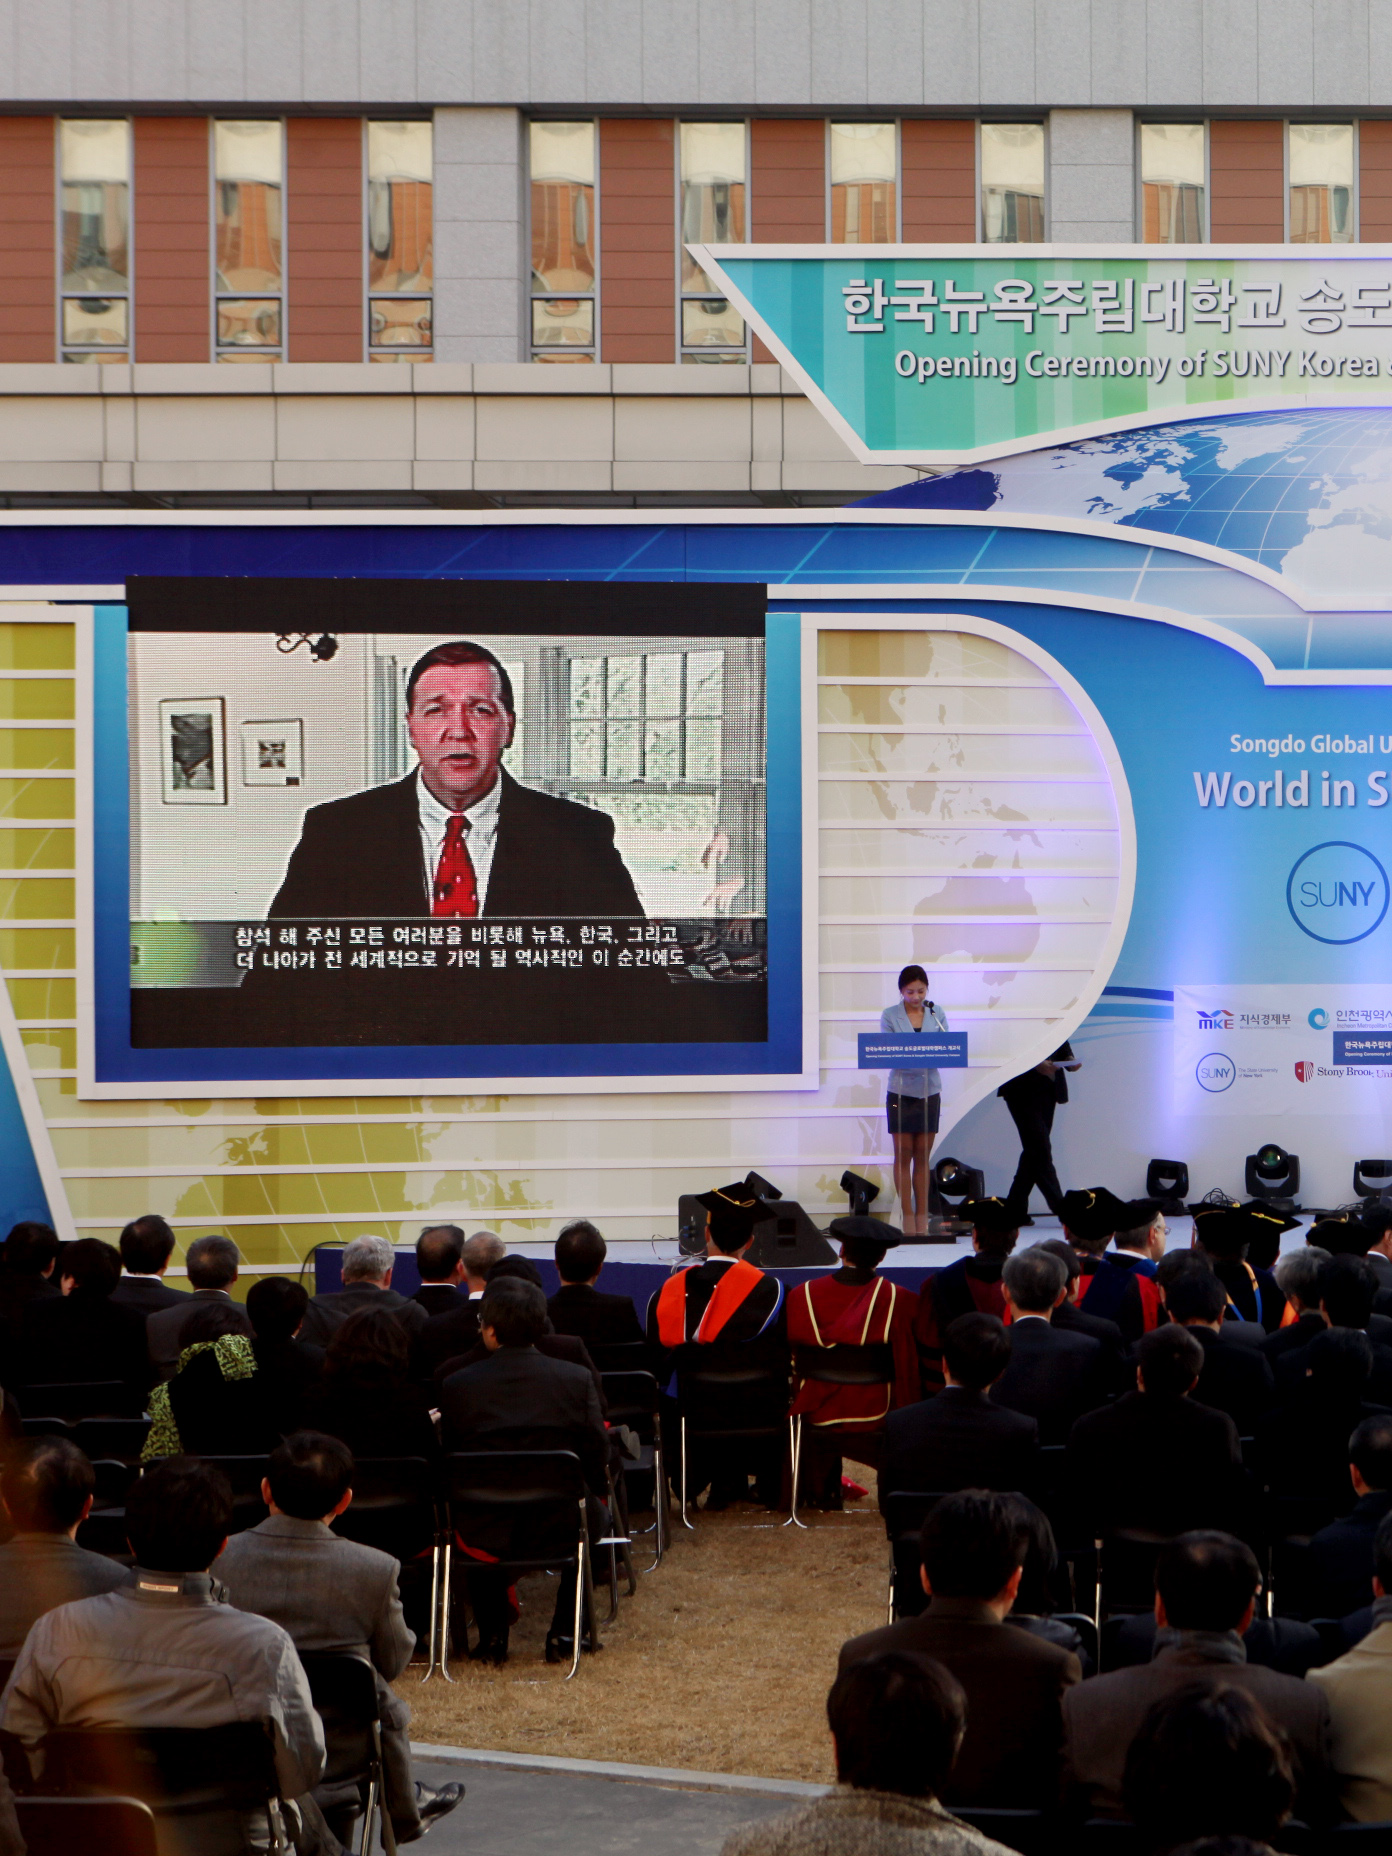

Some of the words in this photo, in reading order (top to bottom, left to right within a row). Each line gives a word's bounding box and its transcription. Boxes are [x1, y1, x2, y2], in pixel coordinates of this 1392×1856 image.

[842, 276, 1285, 335] 한국뉴욕주립대학교
[895, 348, 1019, 384] Opening
[1024, 348, 1170, 384] Ceremony
[1175, 348, 1207, 379] of
[1211, 349, 1292, 378] SUNY
[1298, 349, 1379, 378] Korea
[1229, 734, 1306, 758] Songdo
[1310, 734, 1375, 755] Global
[1193, 769, 1310, 808] World
[1321, 770, 1356, 808] in
[1300, 880, 1376, 908] SUNY
[235, 926, 271, 947] 참석
[279, 926, 298, 946] 해
[306, 926, 341, 946] 주신
[349, 926, 385, 946] 모든
[393, 925, 463, 946] 여러분을
[471, 925, 523, 945] 비롯해
[627, 925, 678, 944] 그리고
[236, 950, 254, 970] 더
[263, 950, 316, 970] 나아가
[324, 950, 342, 969] 전
[350, 950, 438, 969] 세계적으로
[446, 949, 480, 968] 기억
[515, 948, 583, 968] 역사적인
[592, 948, 609, 968] 이
[617, 948, 685, 967] 순간에도
[1239, 1013, 1292, 1026] 지식경제부
[1201, 1067, 1231, 1079] SUNY
[1317, 1066, 1345, 1078] Stony
